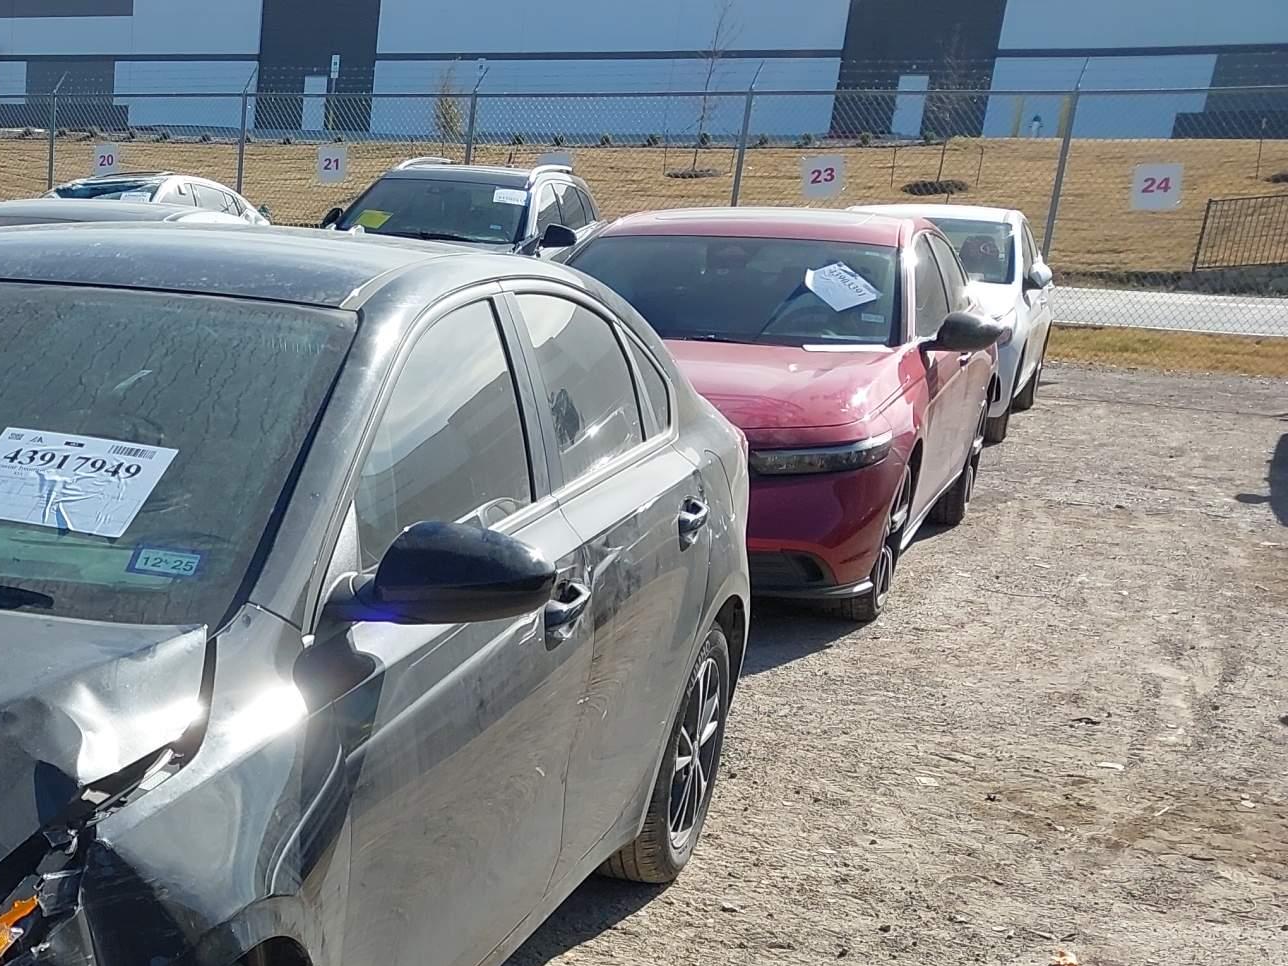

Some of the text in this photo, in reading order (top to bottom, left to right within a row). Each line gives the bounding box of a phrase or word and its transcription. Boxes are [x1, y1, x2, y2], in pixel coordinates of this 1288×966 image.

[98, 153, 114, 167] 20
[323, 157, 340, 171] 21
[810, 167, 835, 184] 23
[1141, 176, 1172, 193] 24
[3, 447, 142, 479] 43917949
[142, 556, 196, 572] 12 25
